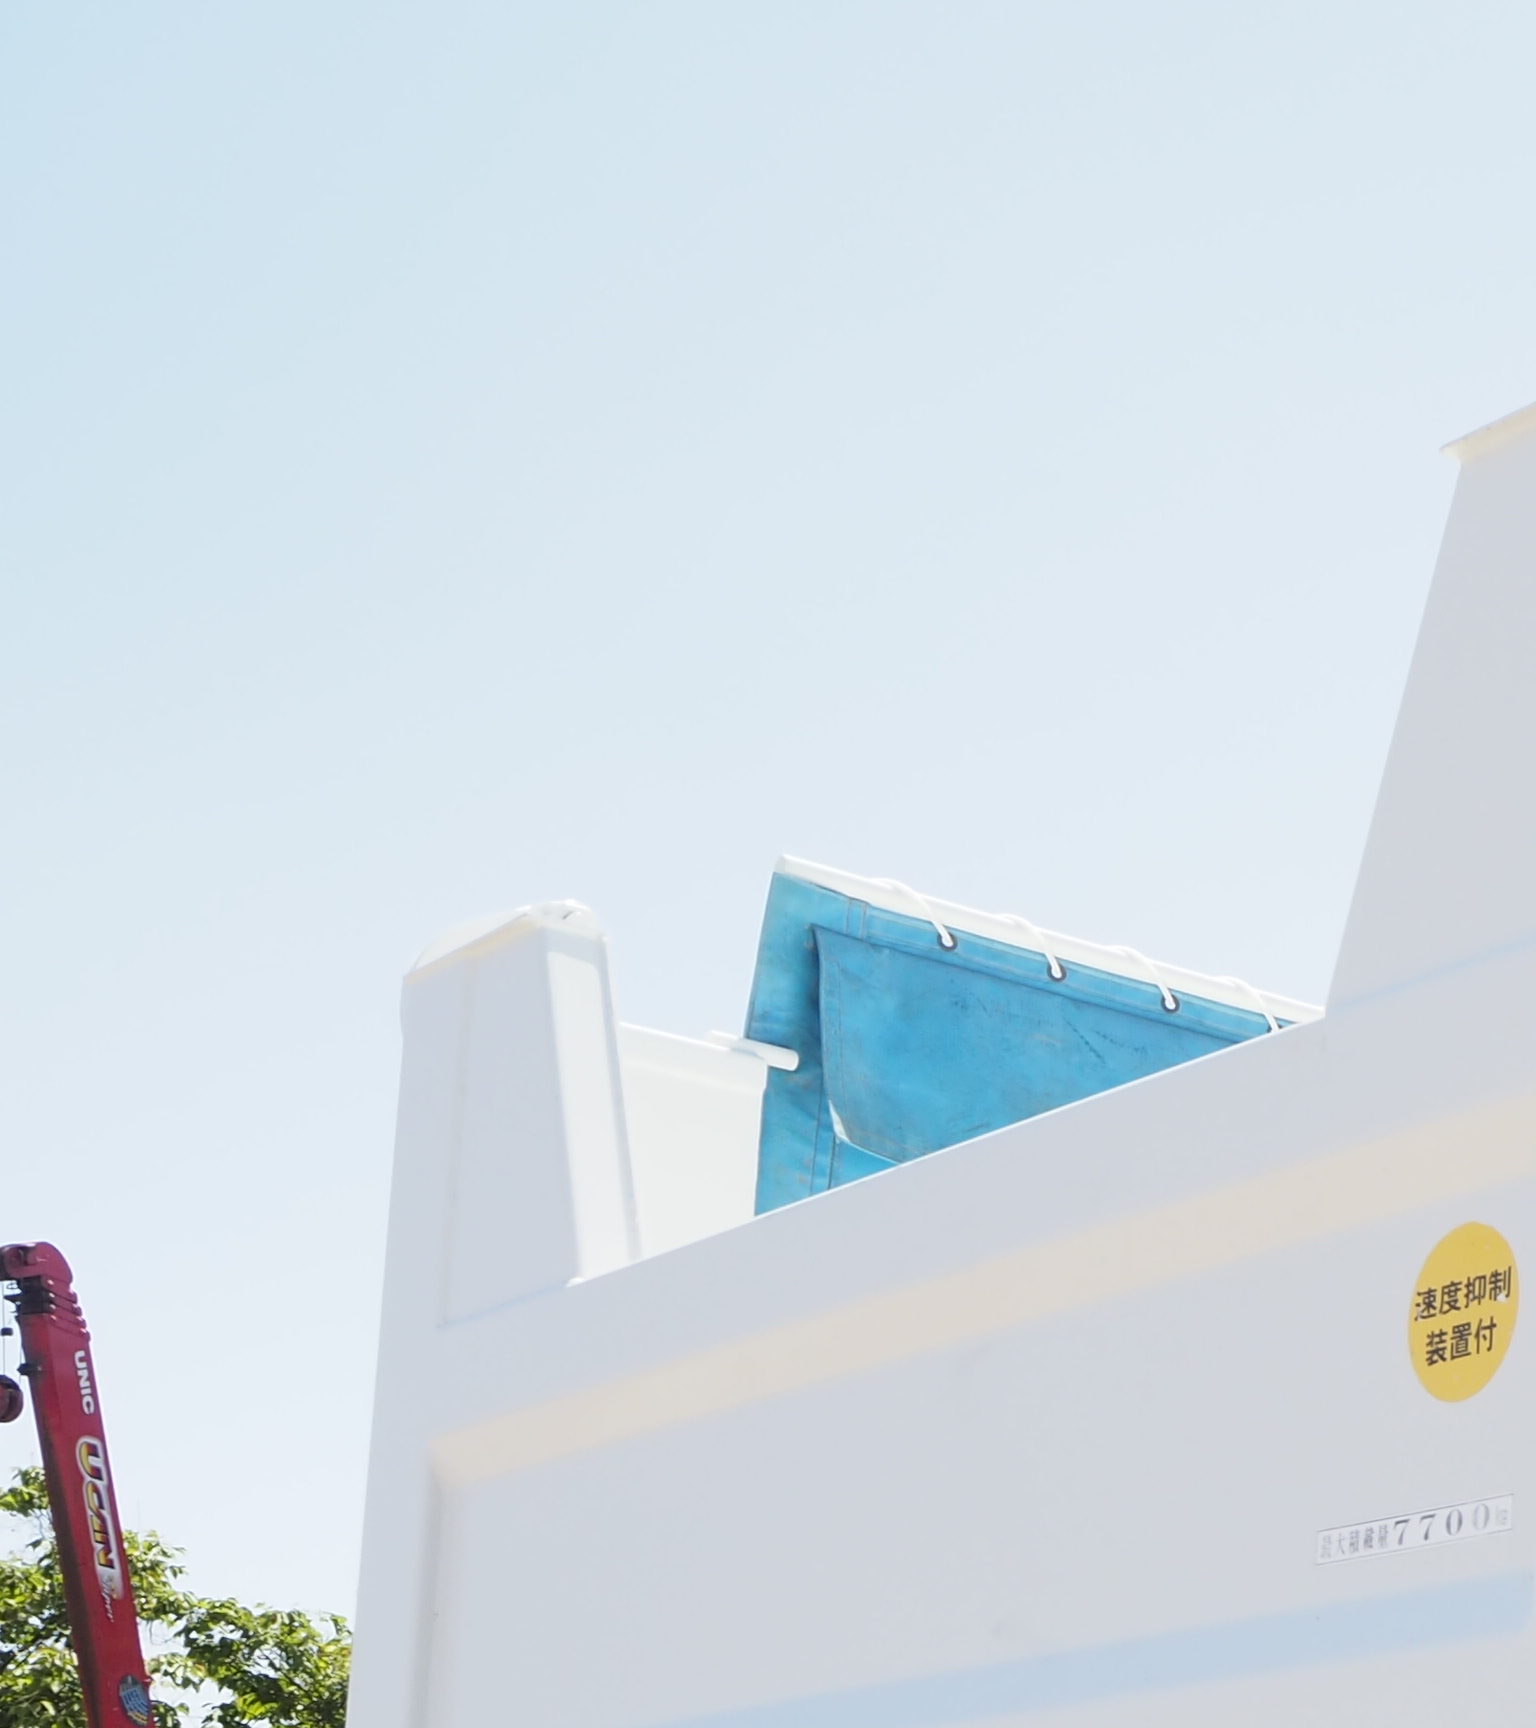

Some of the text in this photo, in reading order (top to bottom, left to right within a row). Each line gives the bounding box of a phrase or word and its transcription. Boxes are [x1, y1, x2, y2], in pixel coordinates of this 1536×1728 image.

[1413, 1265, 1513, 1323] 速度抑制
[1424, 1316, 1498, 1367] 装置付
[74, 1350, 95, 1415] UNIC
[77, 1438, 116, 1570] UCAN
